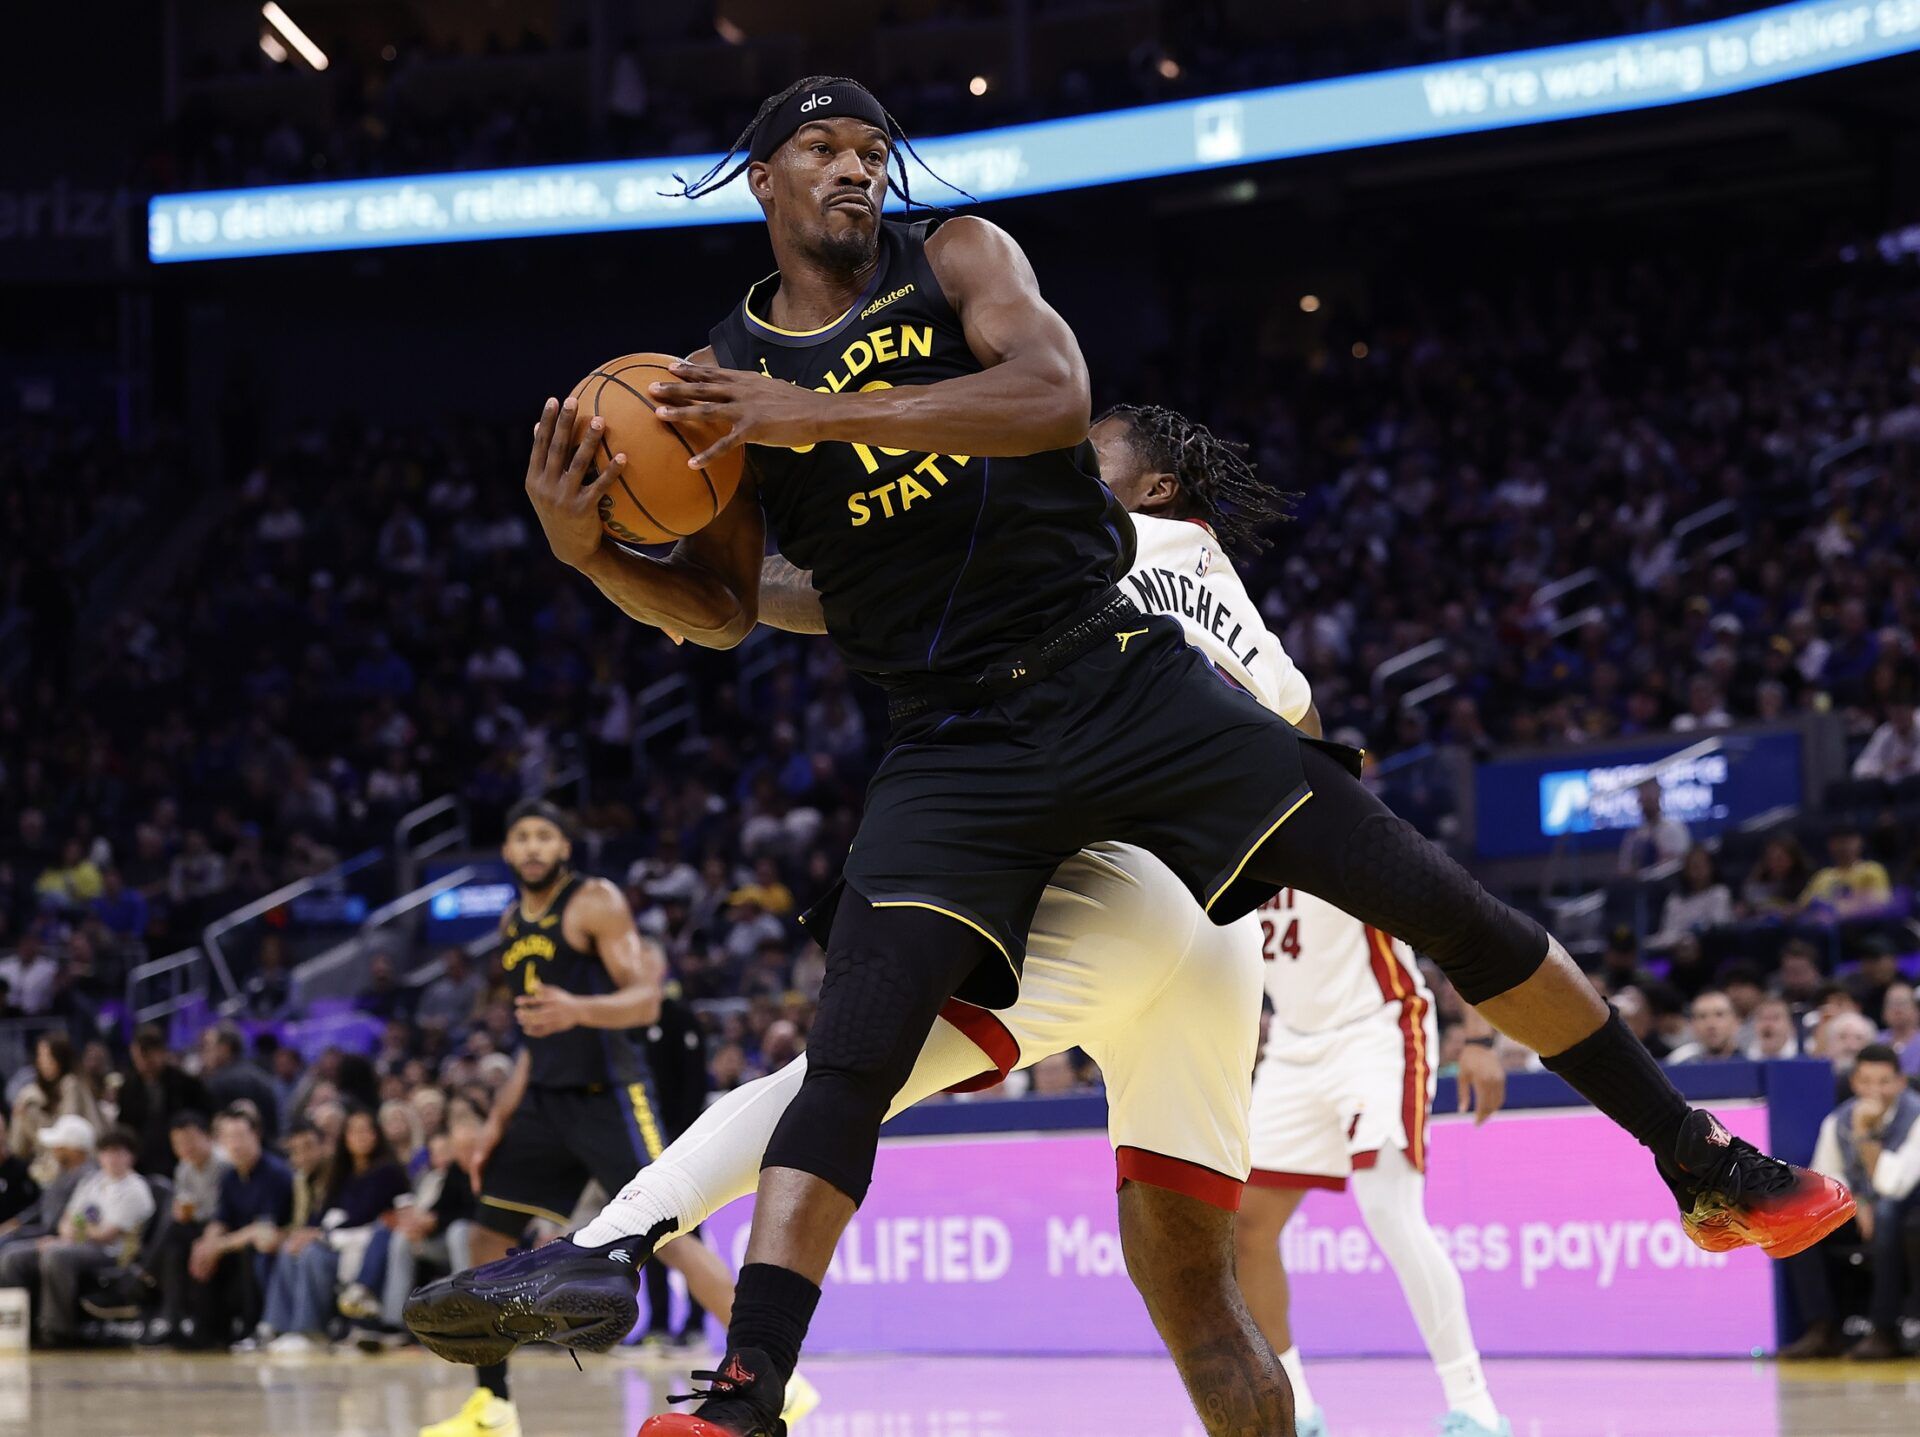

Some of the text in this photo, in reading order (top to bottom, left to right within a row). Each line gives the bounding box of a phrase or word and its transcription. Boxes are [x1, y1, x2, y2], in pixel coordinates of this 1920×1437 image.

[1422, 65, 1540, 117] We're
[1541, 40, 1704, 101] working
[1708, 34, 1748, 77] to
[1751, 6, 1871, 67] deliver
[800, 93, 833, 113] alo
[177, 204, 218, 245] to
[221, 196, 351, 241] deliver
[355, 185, 449, 232] safe,
[453, 175, 612, 224] reliable,
[860, 282, 915, 321] Rakuten
[1127, 567, 1259, 678] MITCHELL
[1260, 918, 1302, 961] 24
[731, 1214, 1013, 1285] LIFIED
